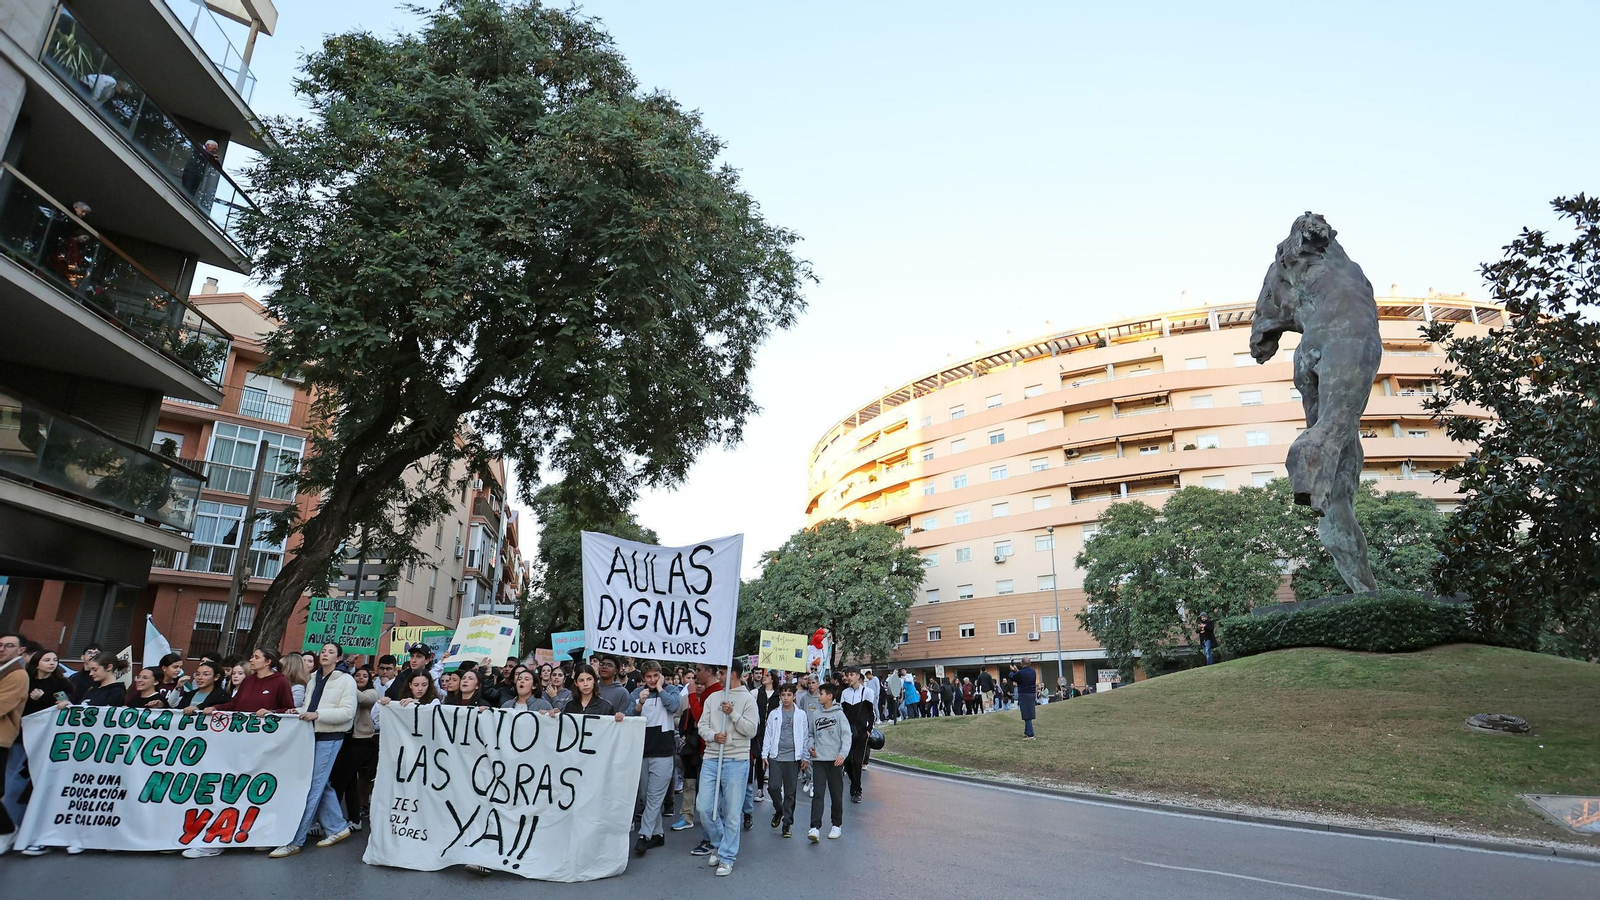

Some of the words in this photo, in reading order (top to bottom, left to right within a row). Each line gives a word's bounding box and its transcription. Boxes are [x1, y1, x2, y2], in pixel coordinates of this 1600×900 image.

[606, 545, 714, 595] AULAS
[316, 600, 360, 612] QUEREMOS
[597, 594, 712, 637] DIGNAS
[311, 612, 327, 622] QUE
[325, 624, 337, 634] LA
[342, 625, 357, 635] LEY
[598, 636, 617, 651] IES
[622, 639, 656, 654] LOLA
[662, 641, 706, 655] FLORES
[56, 706, 99, 727] IES
[104, 706, 174, 730] LOLA
[412, 703, 539, 752] INICIO
[556, 713, 601, 754] DE
[49, 732, 207, 766] EDIFICIO
[72, 773, 94, 785] POR
[97, 774, 121, 786] UNA
[138, 771, 277, 805] NUEVO
[396, 745, 450, 791] LAS
[472, 754, 582, 810] OBRAS
[61, 786, 127, 800] EDUCACIÓN
[68, 798, 114, 812] PÚBLICA
[391, 797, 419, 812] IES
[54, 813, 73, 825] DE
[75, 814, 121, 827] CALIDAD
[178, 806, 260, 845] YA!
[441, 800, 539, 869] YA!!
